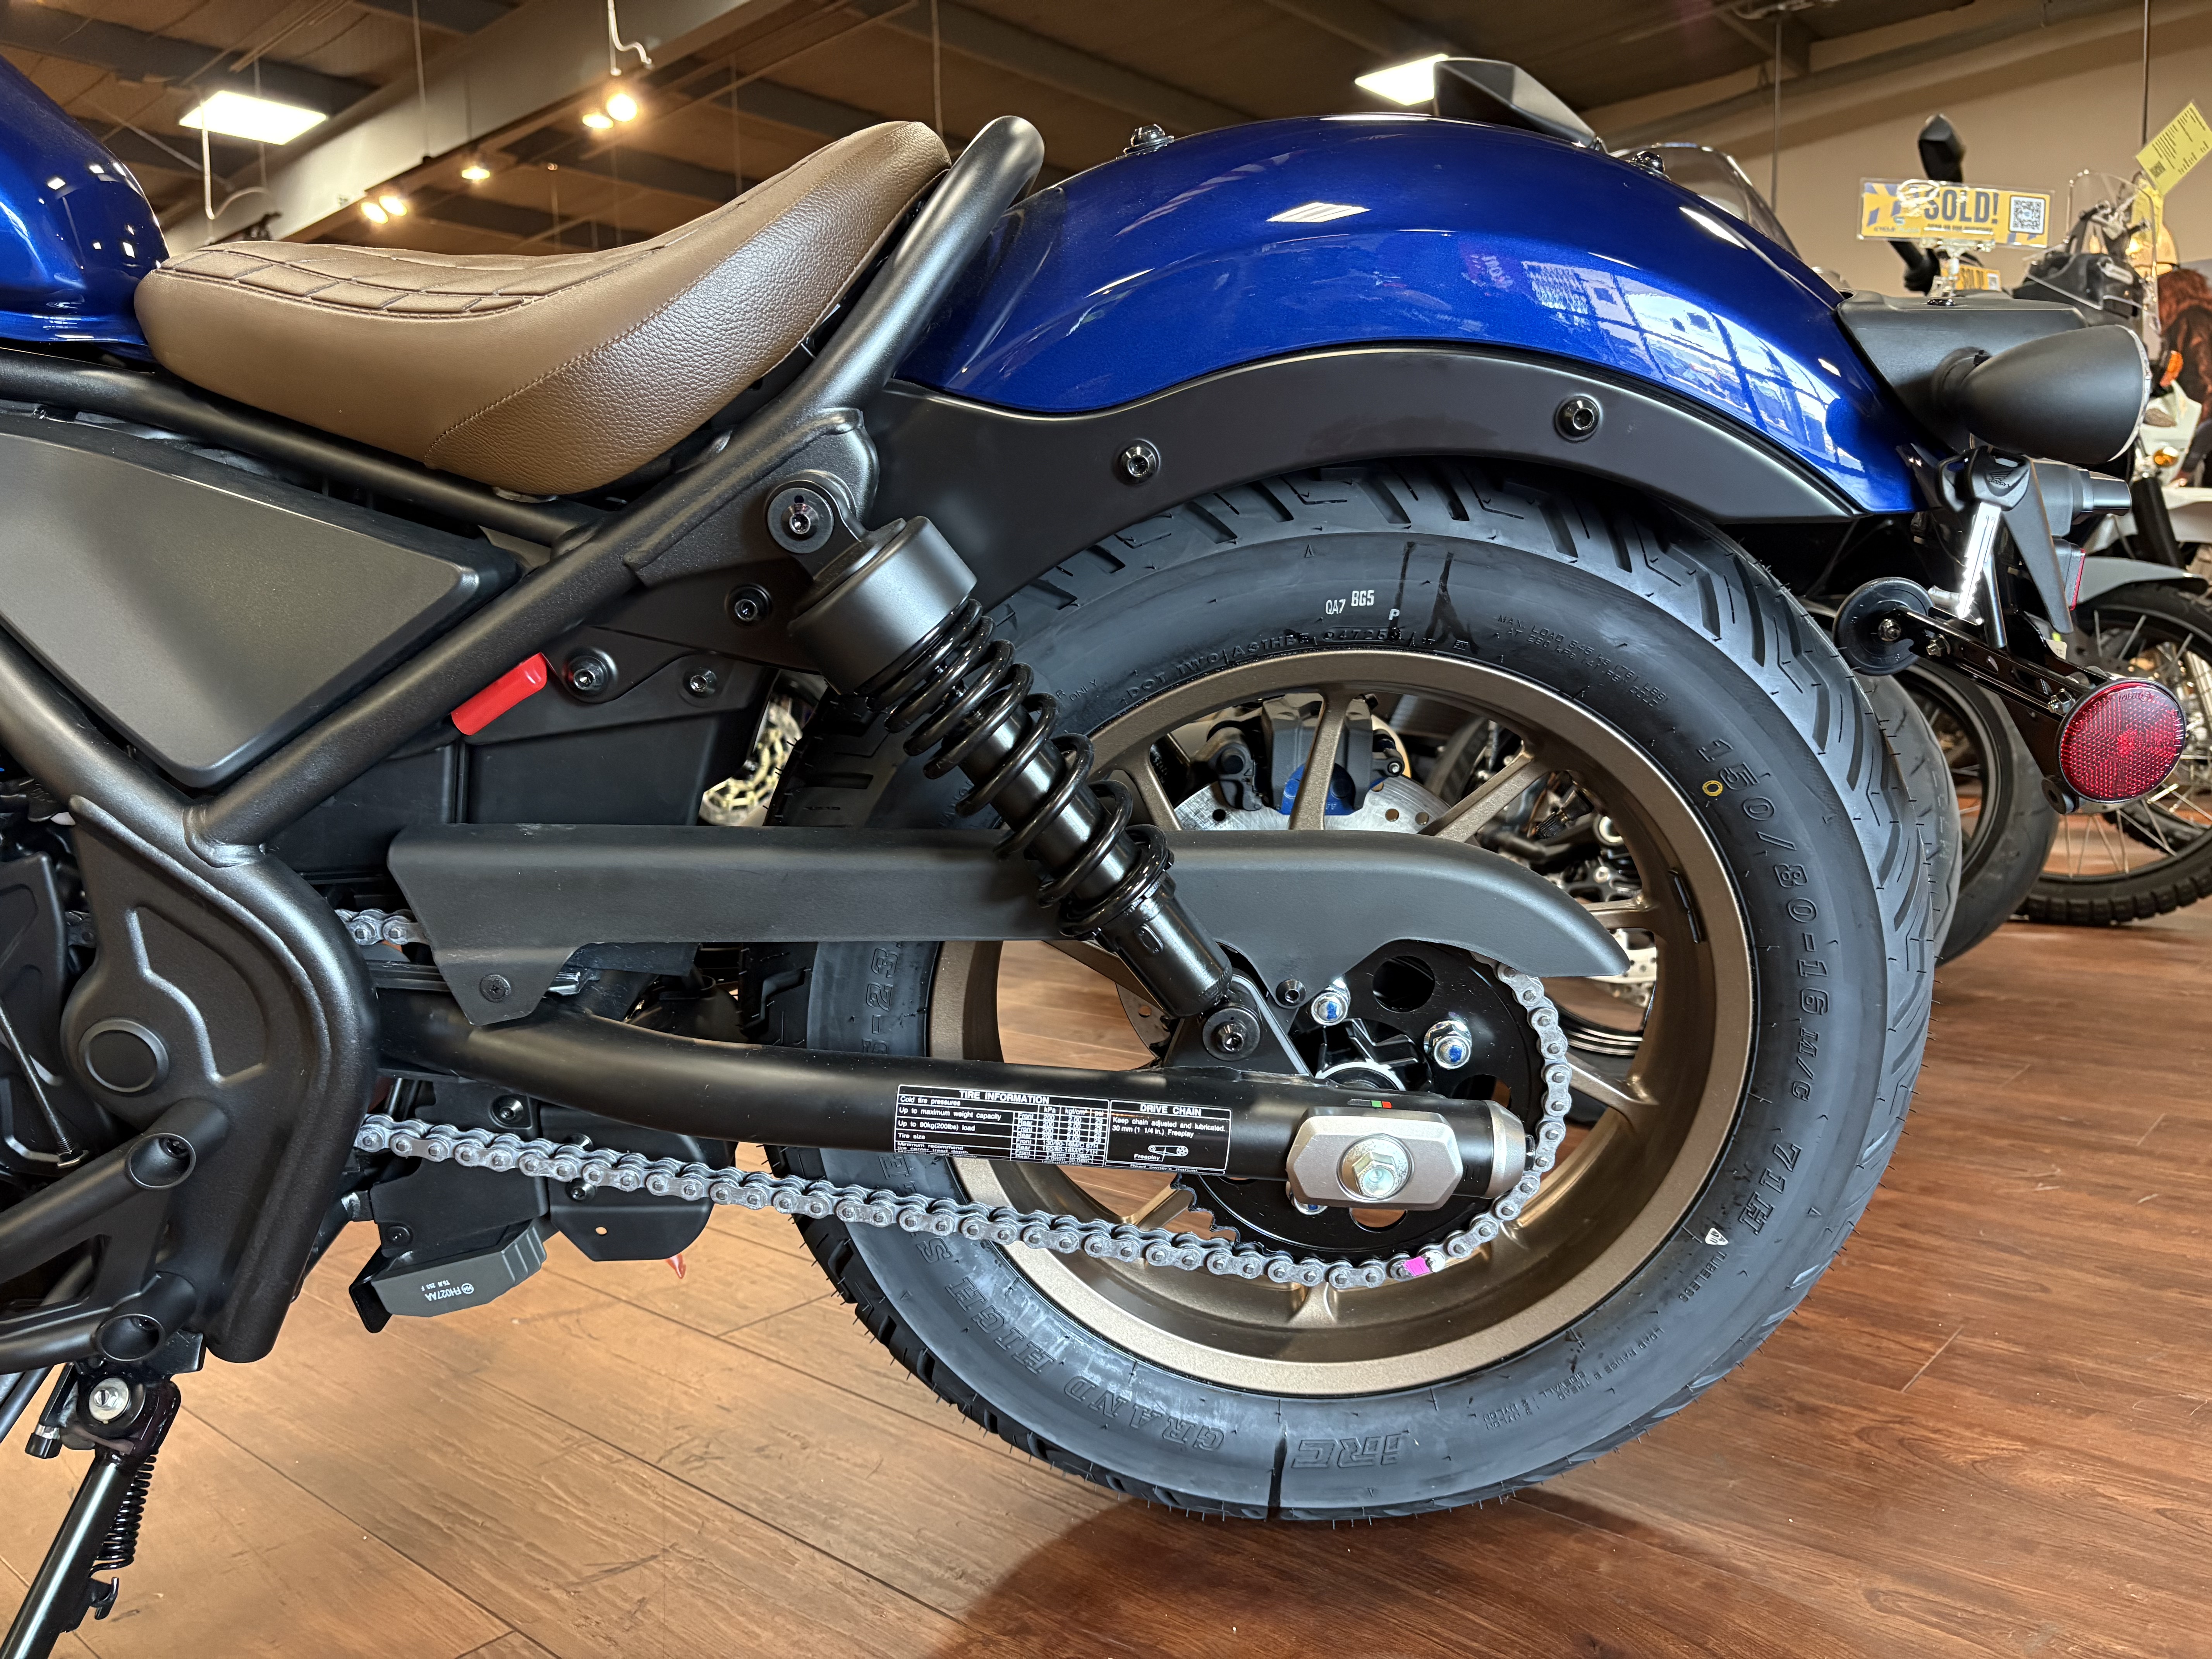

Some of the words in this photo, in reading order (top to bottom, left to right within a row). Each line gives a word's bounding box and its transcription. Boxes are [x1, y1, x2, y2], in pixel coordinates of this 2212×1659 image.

[1924, 189, 1999, 225] SOLD!
[1326, 599, 1346, 615] QA7
[1351, 589, 1374, 607] BG5
[1388, 608, 1400, 620] P
[1532, 625, 1565, 642] LOAD
[1126, 671, 1166, 698] DOT
[1697, 739, 1828, 1015] 150/80-16
[1791, 1027, 1820, 1103] M/C
[959, 1090, 980, 1099] TIRE
[984, 1092, 1049, 1104] INFORMATION
[1140, 1104, 1168, 1113] DRIVE
[1173, 1107, 1202, 1116] CHAIN
[920, 1121, 958, 1131] 90kg(200lbs)
[976, 1113, 1001, 1121] capacity
[1113, 1116, 1129, 1125] Keep
[1151, 1120, 1176, 1128] adjusted
[1195, 1123, 1225, 1132] lubricated.
[1168, 1130, 1194, 1139] Freeplay
[1738, 1142, 1802, 1235] 71H
[1678, 1252, 1727, 1303] TUBELESS
[425, 1286, 462, 1301] FH027AA
[944, 1276, 1056, 1375] HIGH
[1638, 1324, 1665, 1350] LOAD
[1064, 1375, 1225, 1453] GRAND
